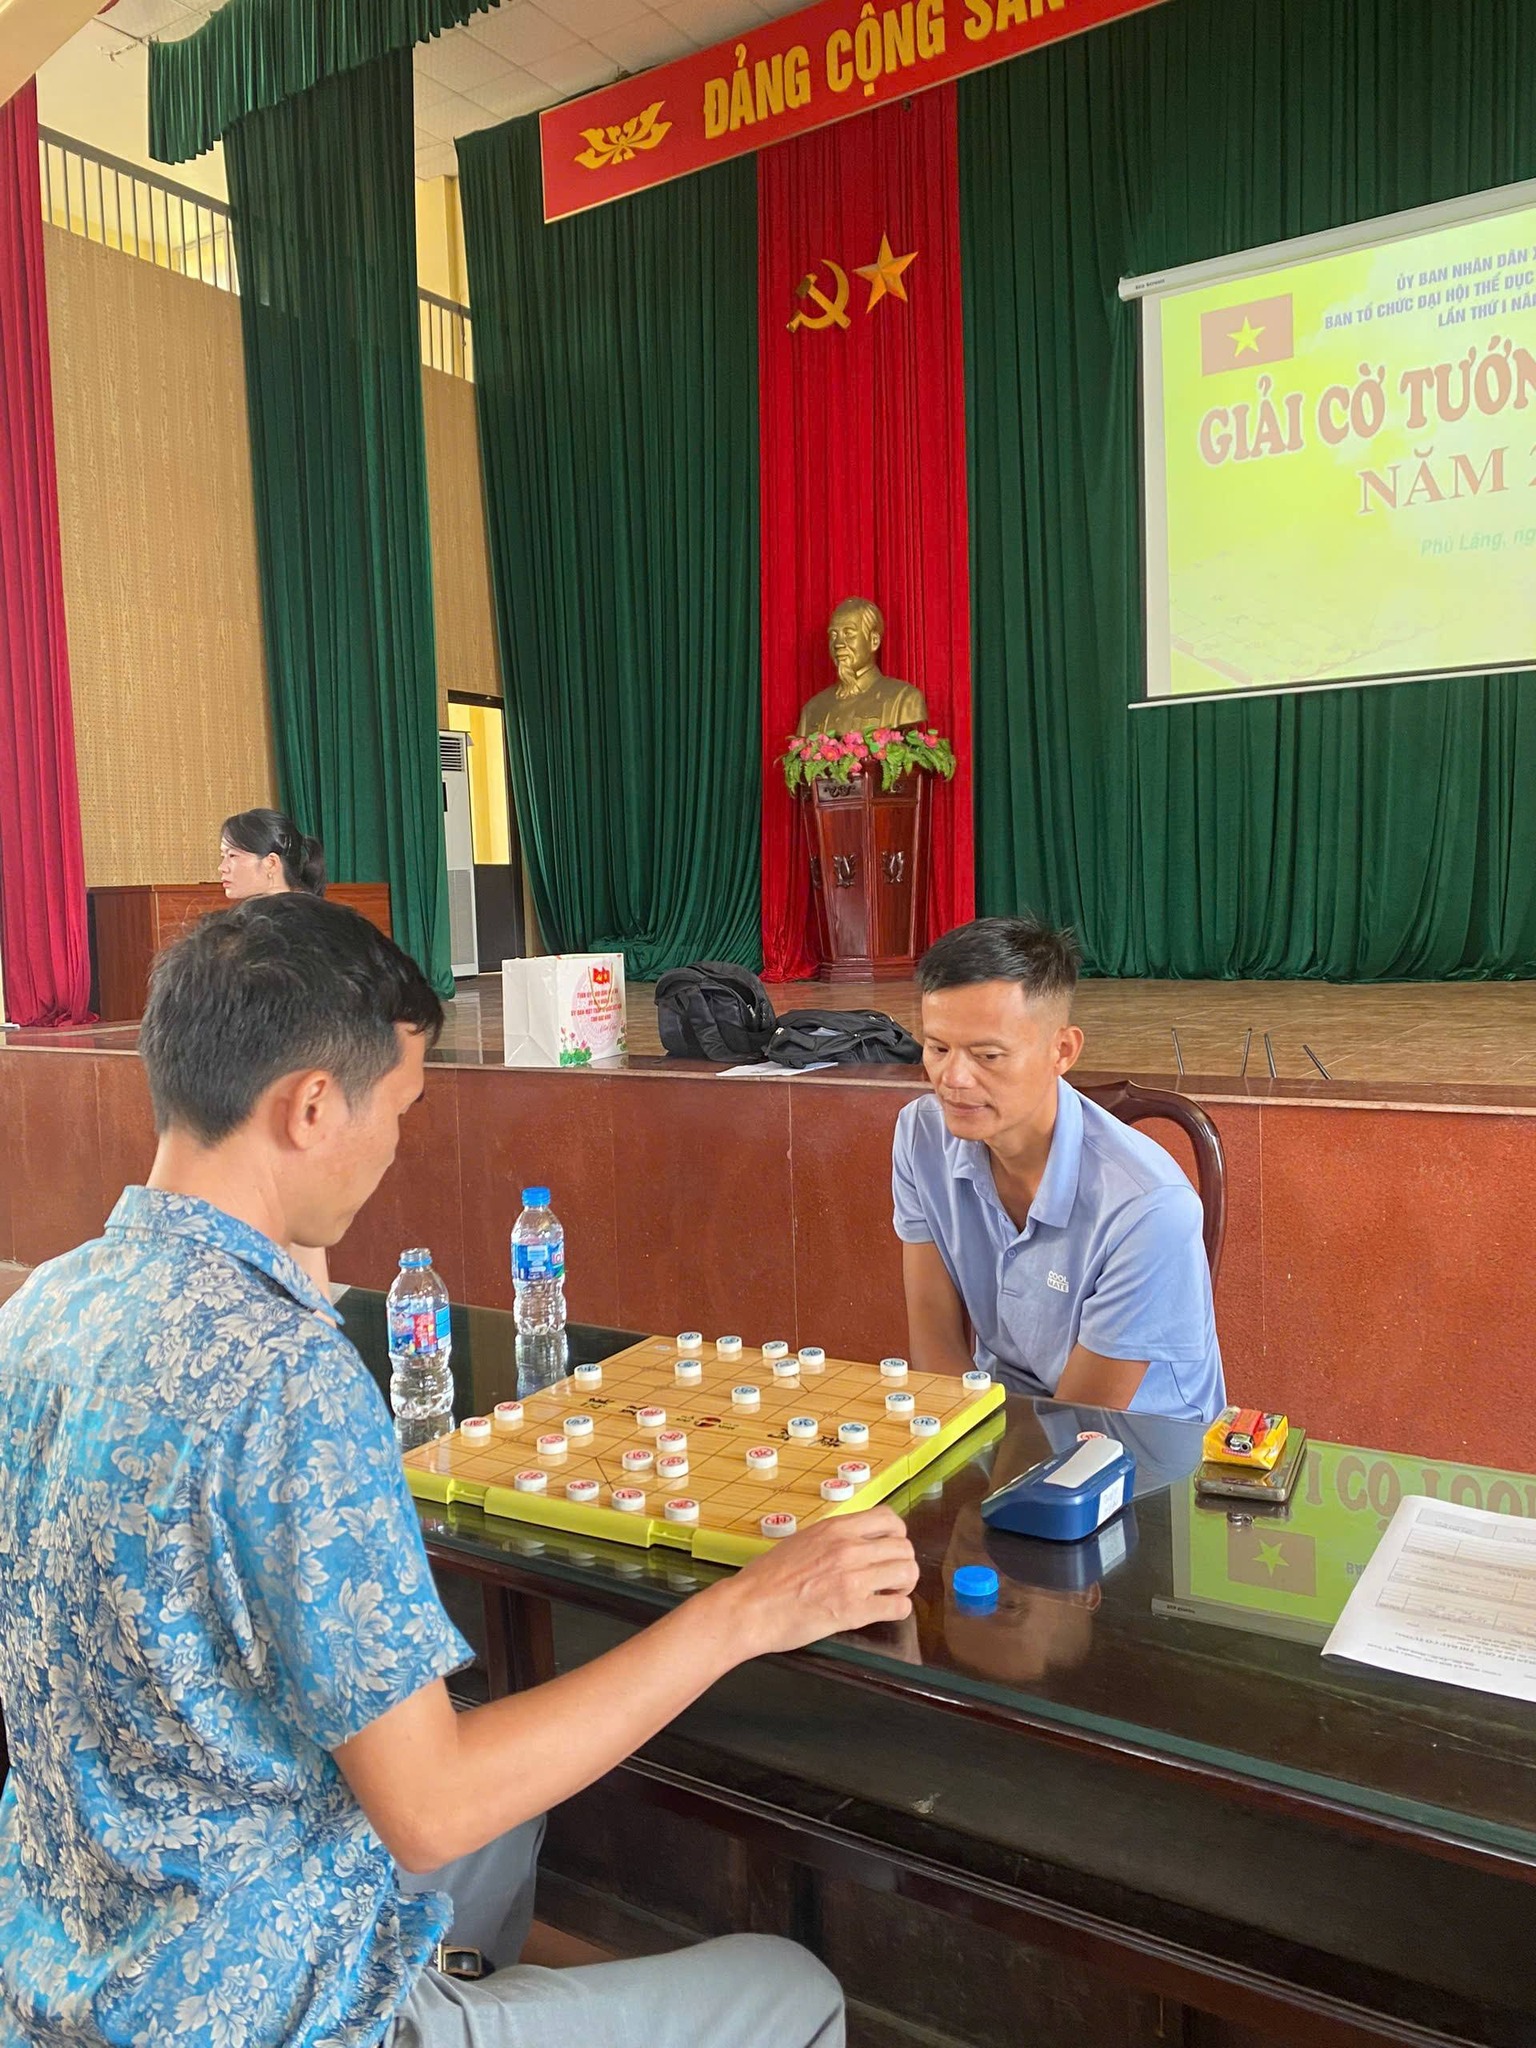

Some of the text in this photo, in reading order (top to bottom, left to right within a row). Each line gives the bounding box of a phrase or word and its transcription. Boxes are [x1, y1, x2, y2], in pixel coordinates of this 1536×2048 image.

[703, 44, 811, 139] ĐẢNG
[825, 3, 946, 96] CỘNG
[1324, 311, 1353, 329] BAN
[1376, 296, 1413, 318] CHỨC
[1417, 291, 1441, 311] ĐẠI
[1445, 283, 1470, 303] HỘI
[1396, 271, 1414, 290] ỦY
[1418, 267, 1448, 286] BAN
[1452, 256, 1493, 280] NHÂN
[1200, 375, 1304, 465] GIẢI
[1318, 362, 1386, 445] CỜ
[1358, 446, 1510, 514] NĂM
